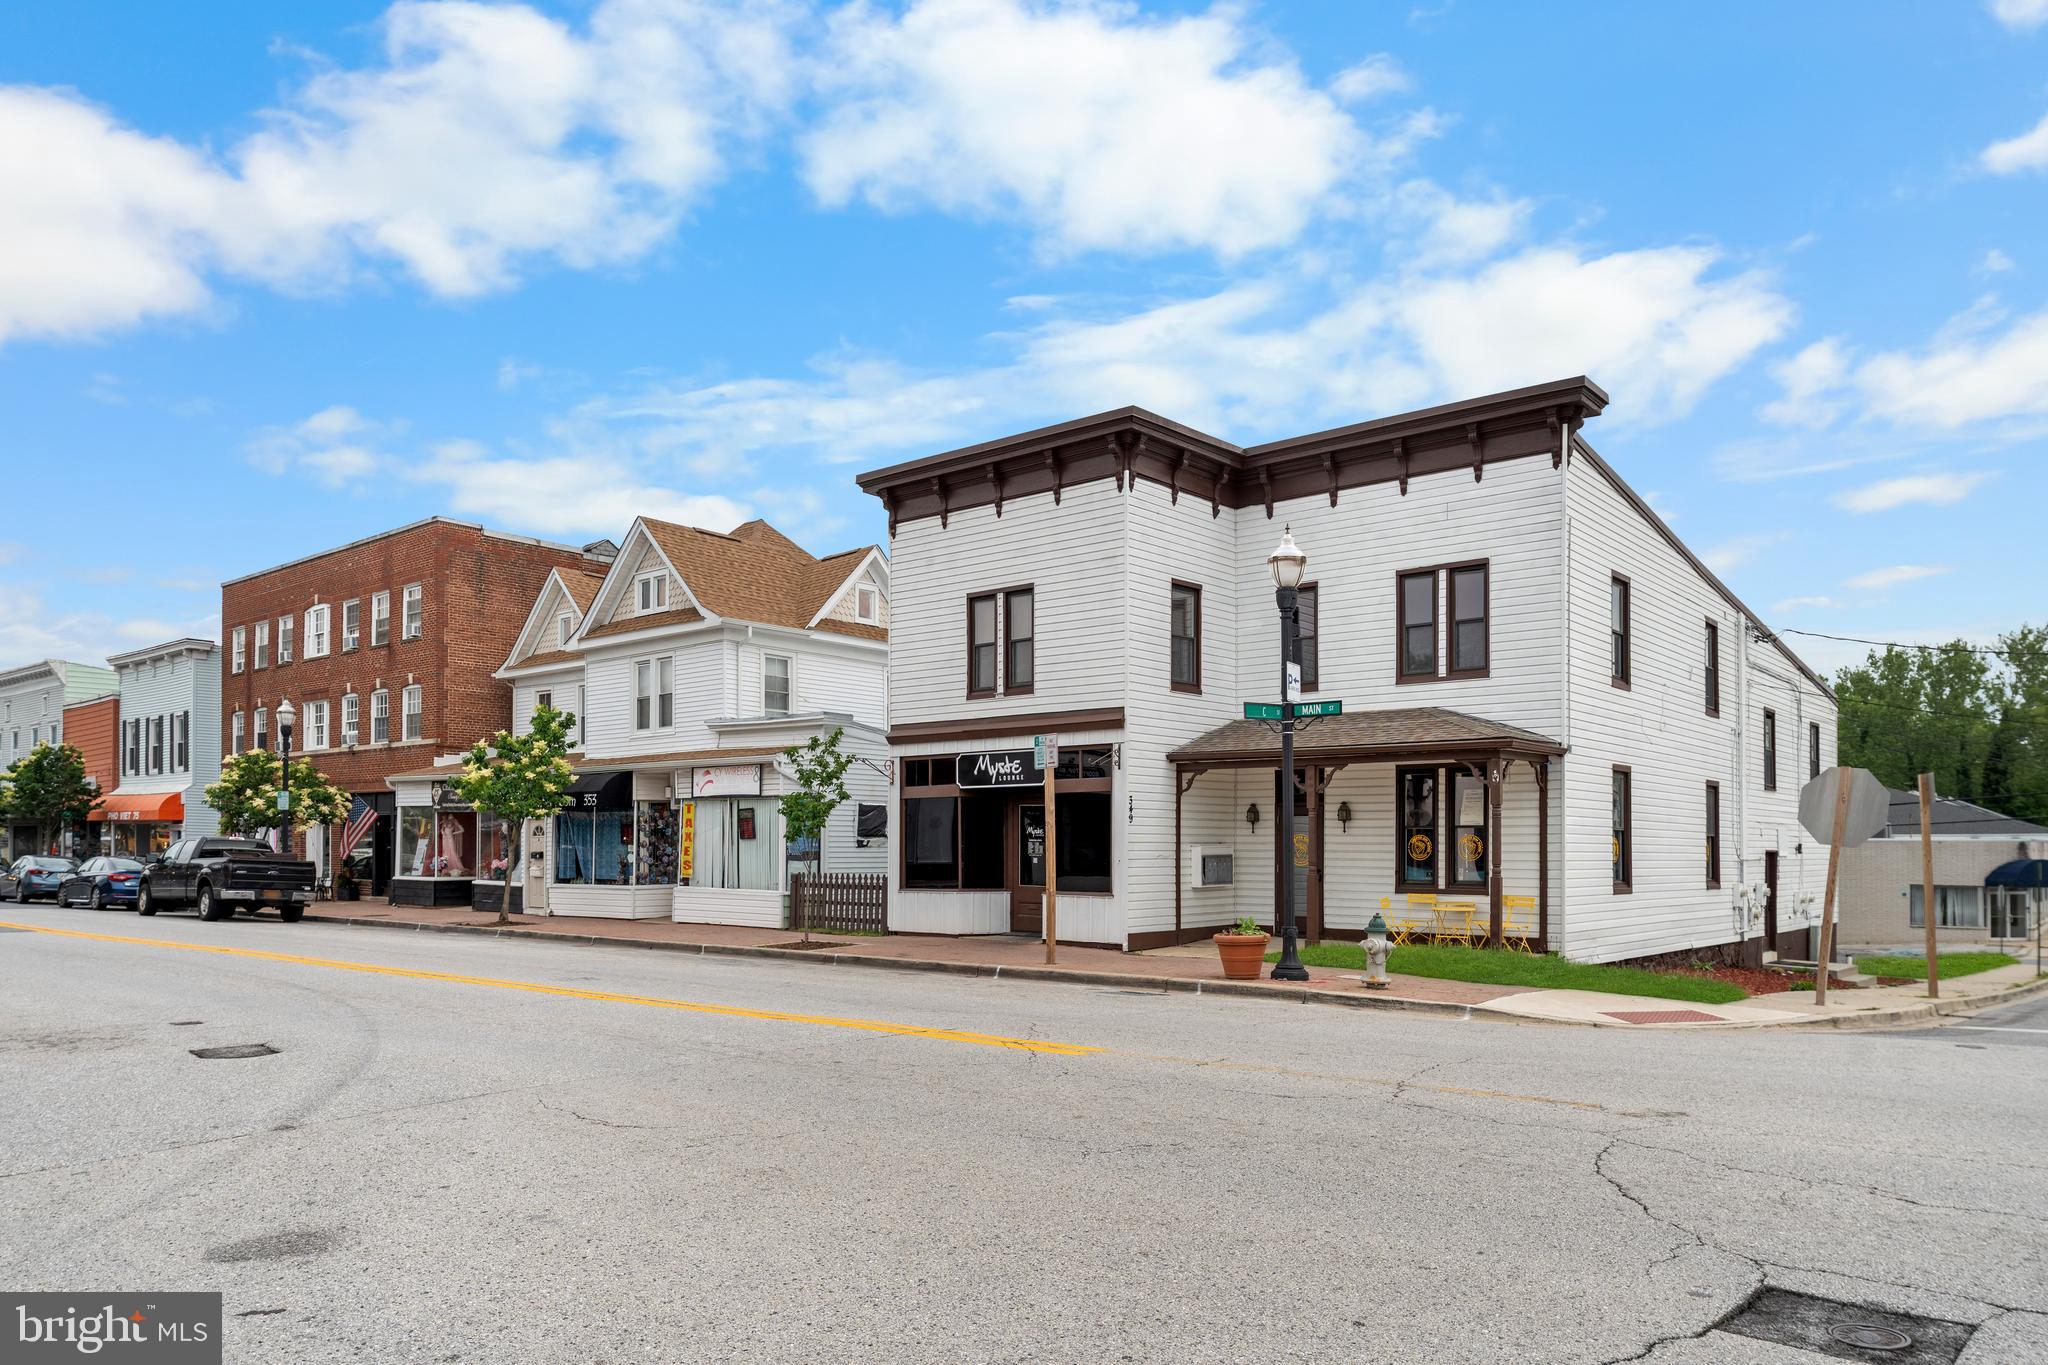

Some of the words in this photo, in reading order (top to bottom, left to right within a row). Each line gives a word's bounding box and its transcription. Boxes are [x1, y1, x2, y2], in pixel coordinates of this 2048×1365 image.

[1262, 707, 1267, 717] C
[1302, 704, 1321, 715] MAIN
[583, 793, 597, 806] 353
[107, 811, 118, 820] PHO
[120, 811, 131, 820] VIET
[683, 803, 694, 870] TAXES
